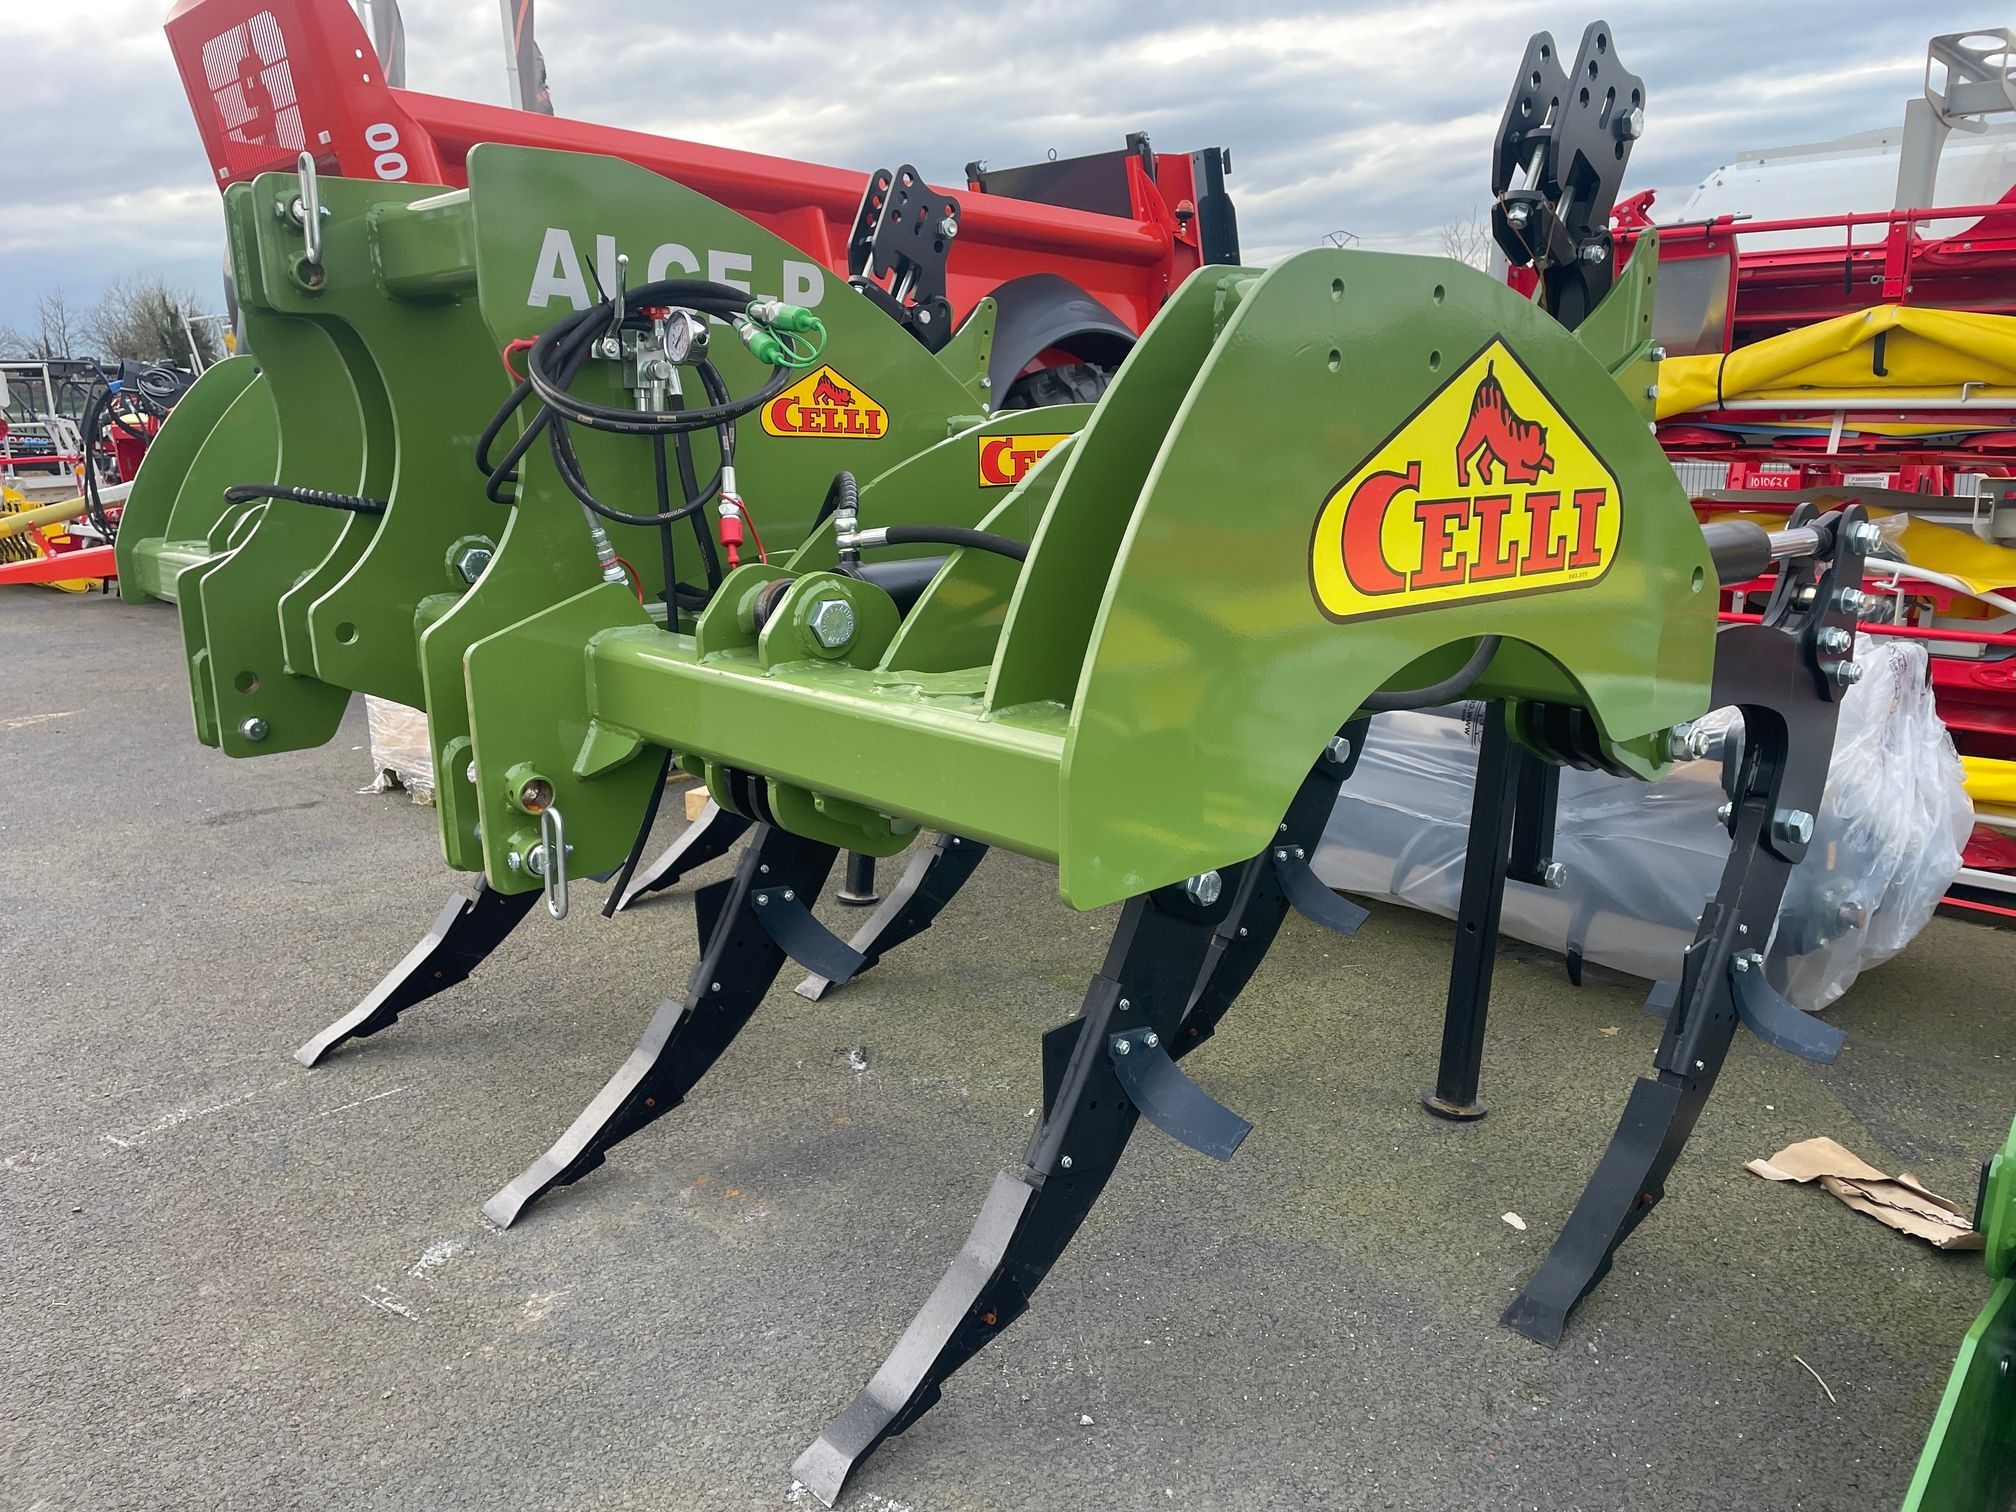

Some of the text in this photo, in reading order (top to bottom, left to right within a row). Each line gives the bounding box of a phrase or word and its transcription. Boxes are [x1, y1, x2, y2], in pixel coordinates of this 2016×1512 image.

[771, 396, 880, 435] CELLI
[1750, 475, 1790, 488] 1010626
[1341, 460, 1607, 596] CELLI
